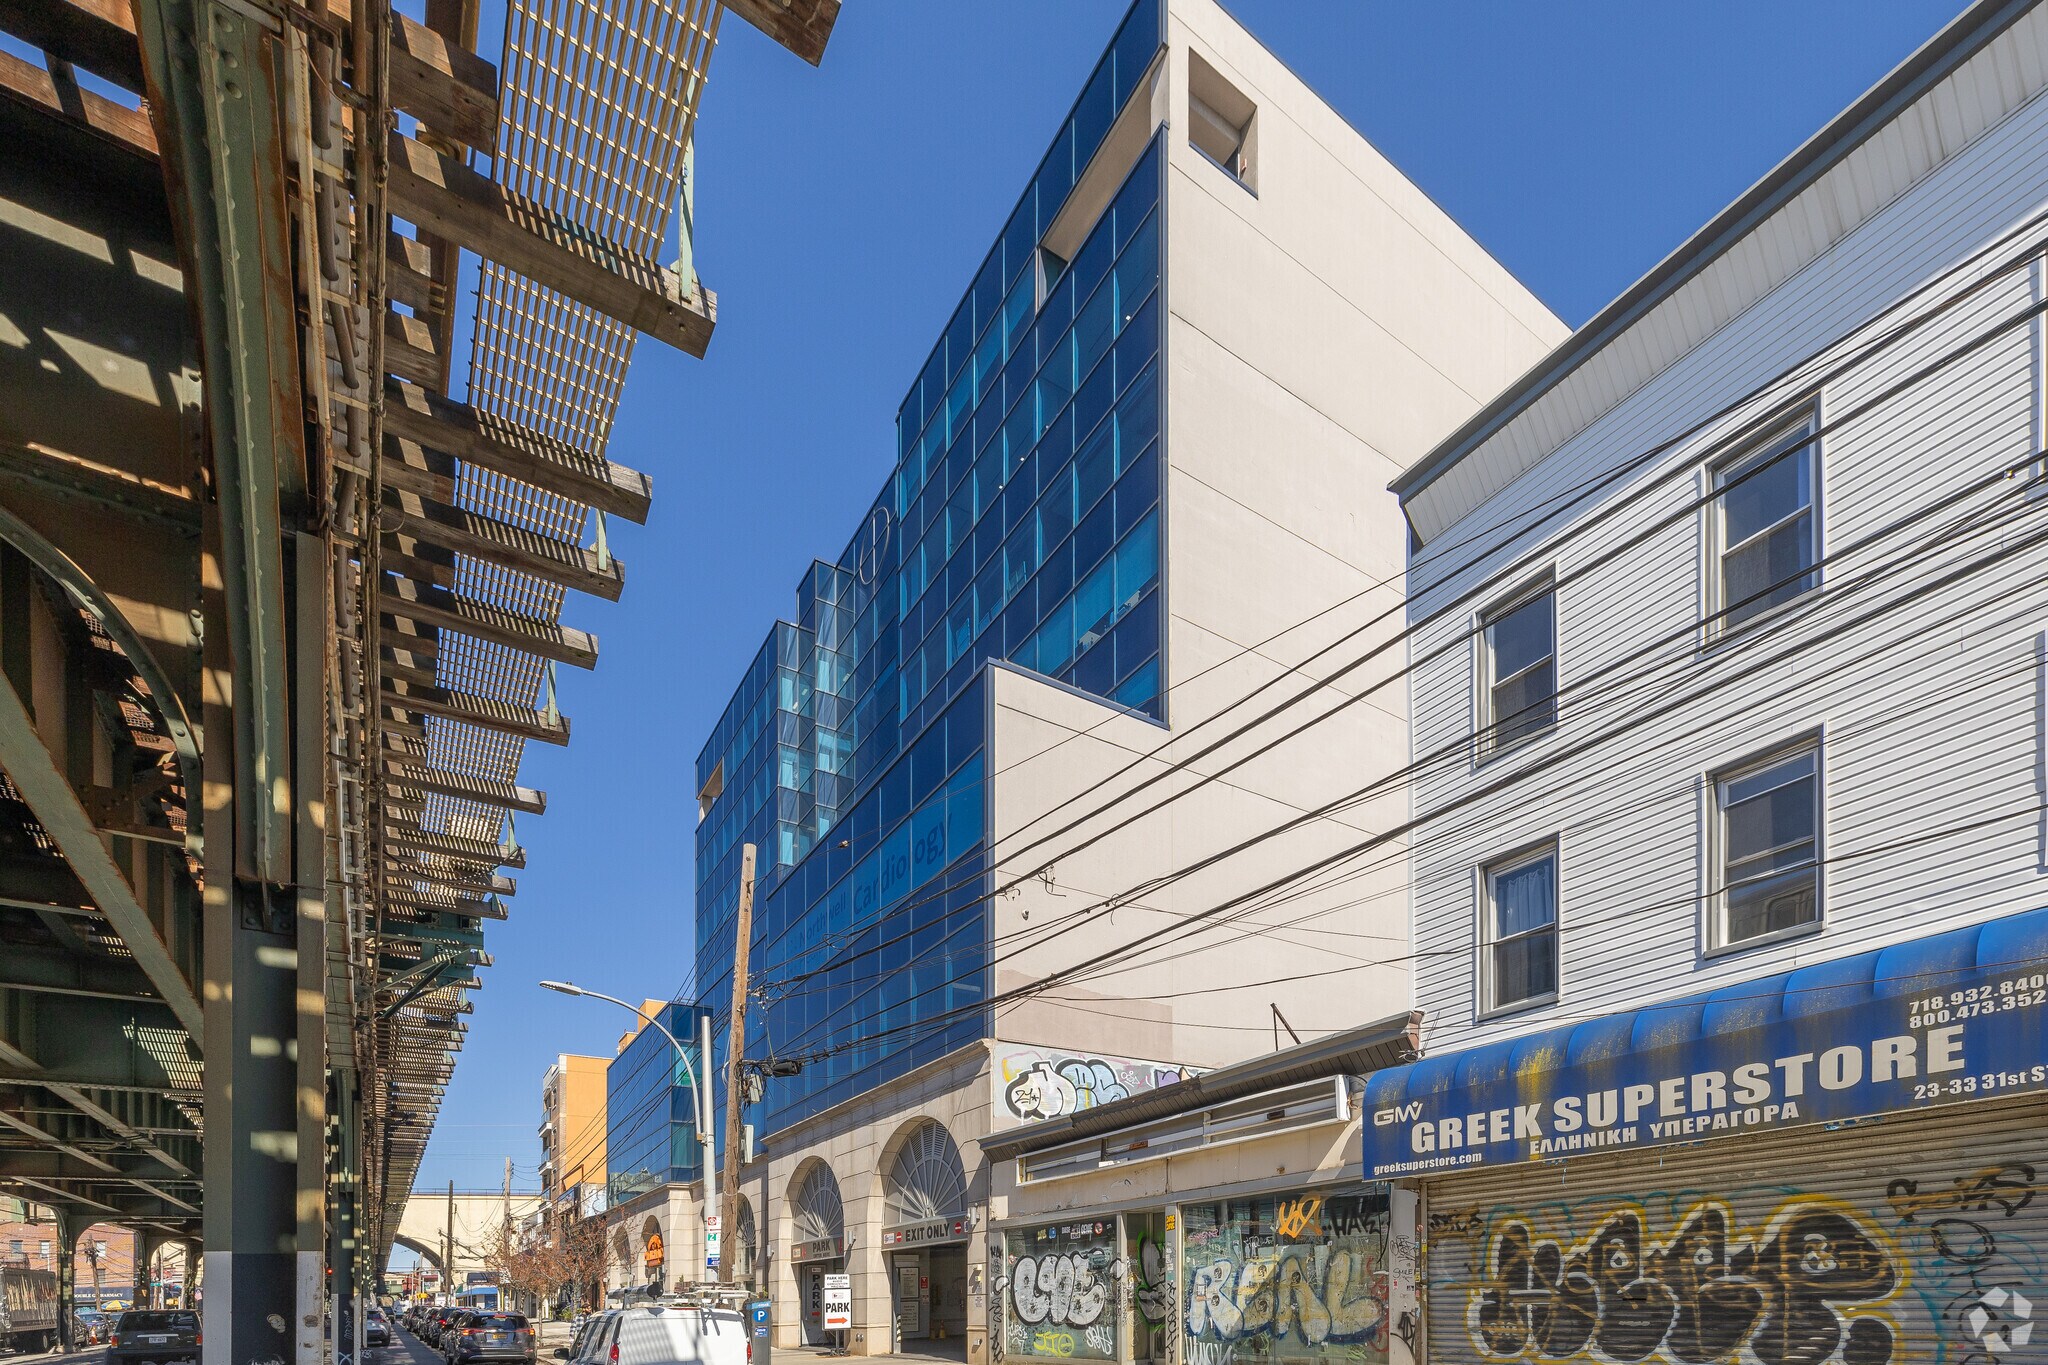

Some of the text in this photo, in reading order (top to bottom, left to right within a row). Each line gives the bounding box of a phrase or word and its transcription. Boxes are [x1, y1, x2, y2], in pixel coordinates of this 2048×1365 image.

[853, 812, 953, 915] Cardiology
[1909, 974, 2048, 1014] 718.932.840
[1411, 1024, 1965, 1154] GREEK SUPERSTORE
[1914, 1064, 2048, 1100] 23-33 31st S
[1374, 1152, 1482, 1176] greeksuperstore.com
[812, 1240, 831, 1253] PARK
[905, 1227, 925, 1242] EXIT
[926, 1223, 950, 1239] ONLY
[812, 1274, 820, 1309] PARK
[825, 1302, 850, 1313] PARK
